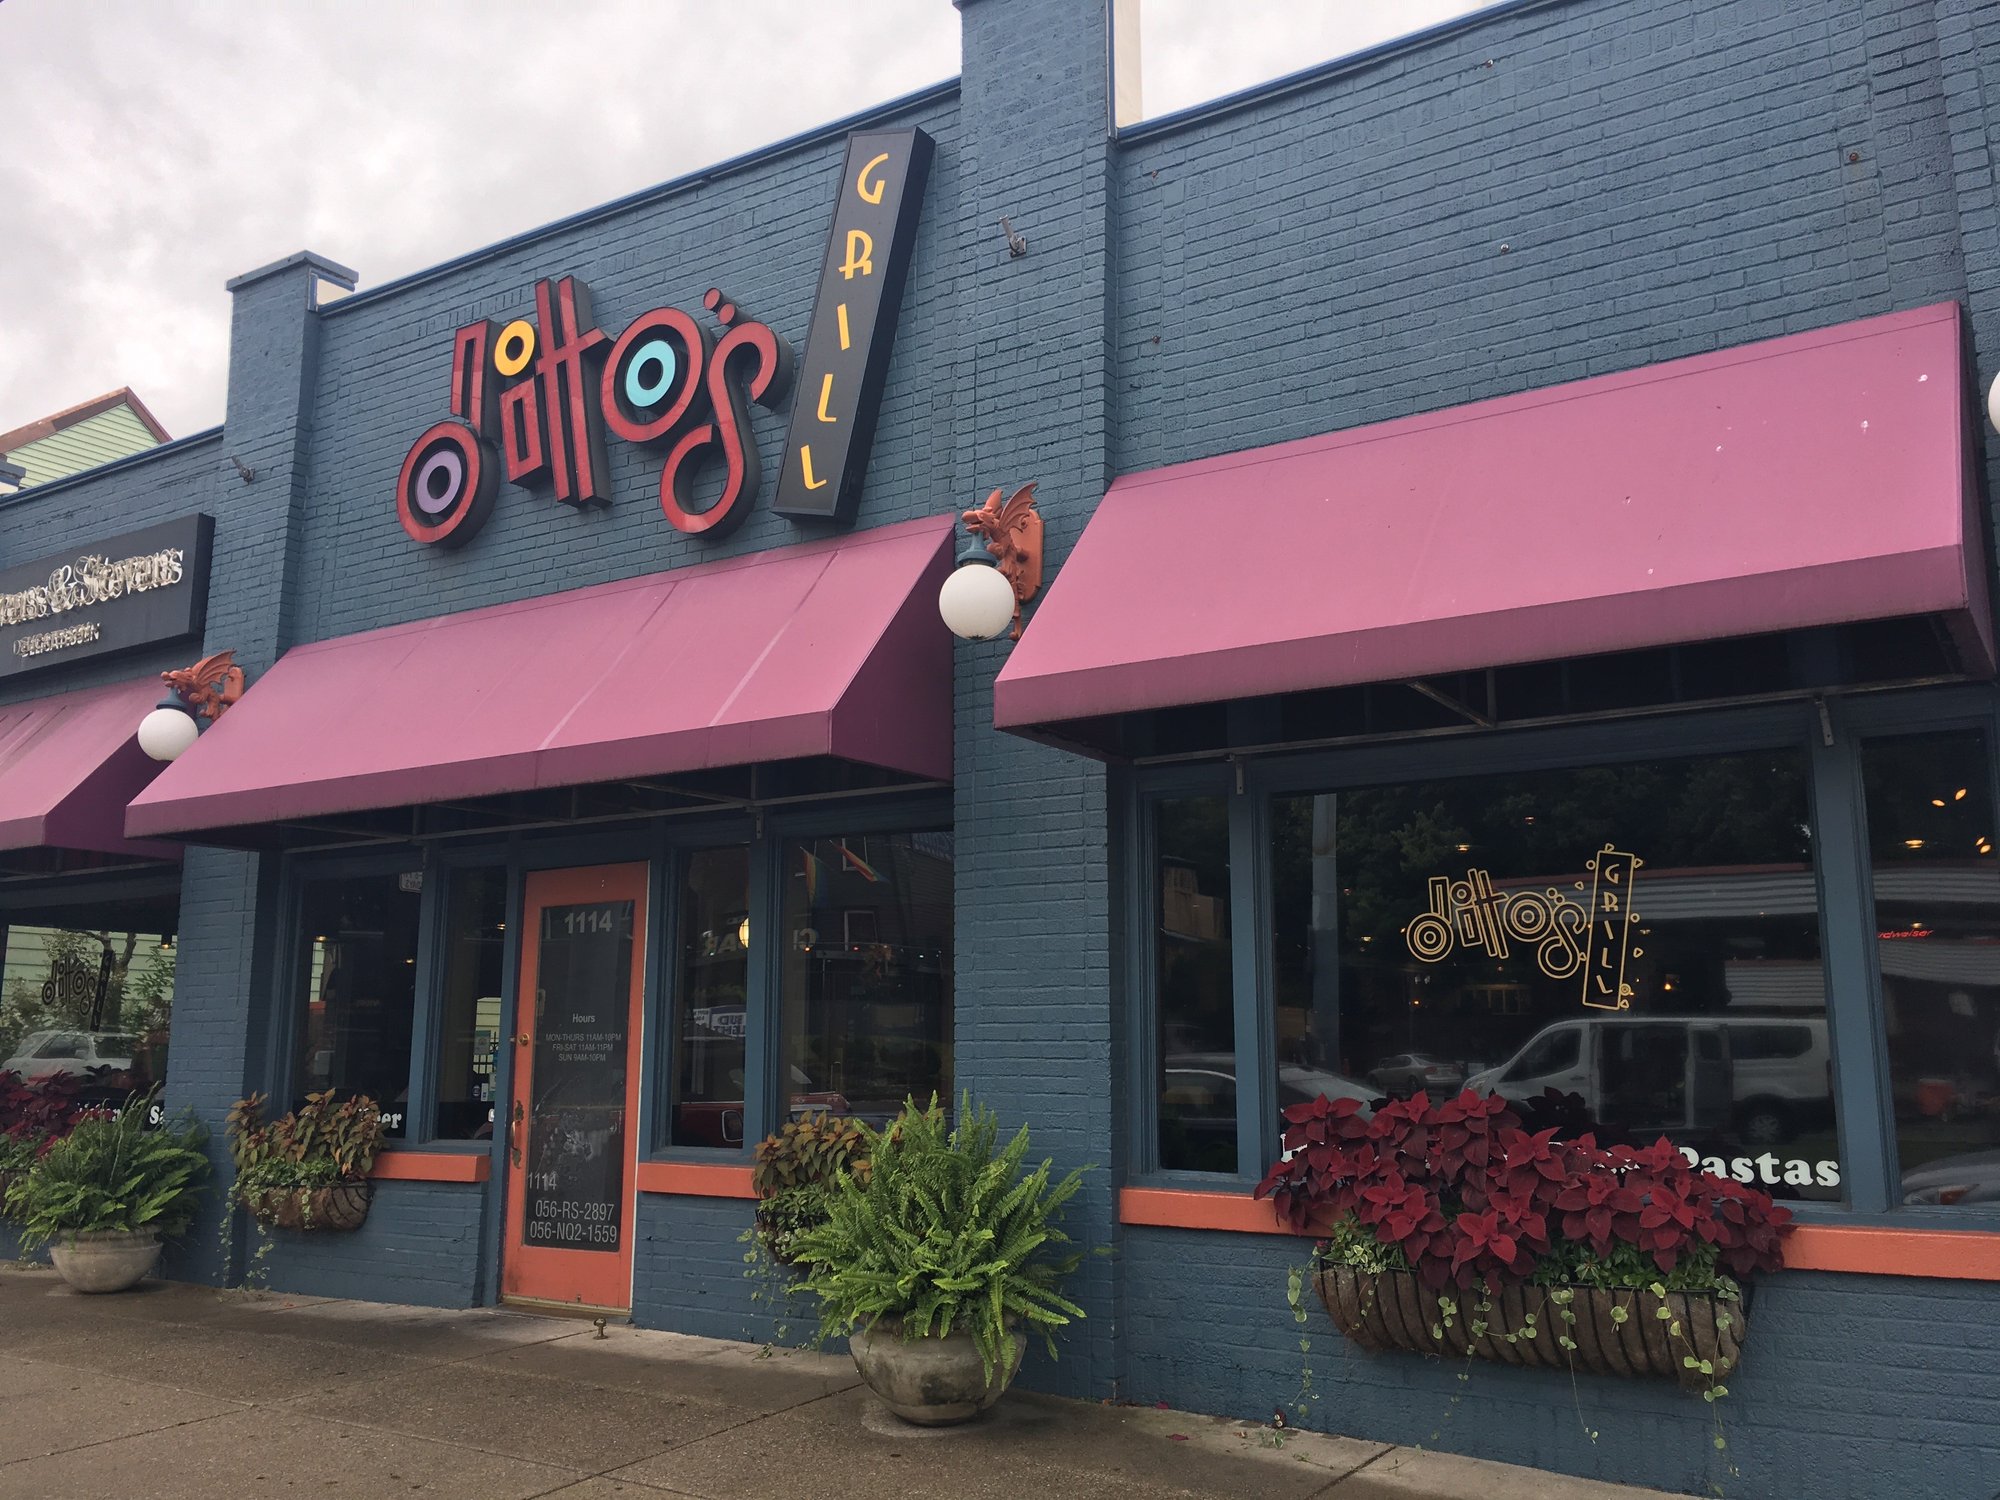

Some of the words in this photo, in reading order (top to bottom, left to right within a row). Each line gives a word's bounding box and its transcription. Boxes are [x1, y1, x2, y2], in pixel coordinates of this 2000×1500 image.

[801, 152, 889, 490] GRILL
[564, 909, 613, 934] 1114
[1596, 863, 1621, 994] GRILL
[572, 1013, 596, 1024] Hours
[545, 1032, 585, 1042] MON-THURS
[552, 1043, 577, 1051] FRI-SAT
[578, 1043, 614, 1051] 11AM-11PM
[558, 1053, 573, 1062] SUN
[528, 1172, 558, 1192] 1114
[535, 1200, 616, 1221] 056-RS-2897
[529, 1221, 618, 1243] 056-NQ2-1559
